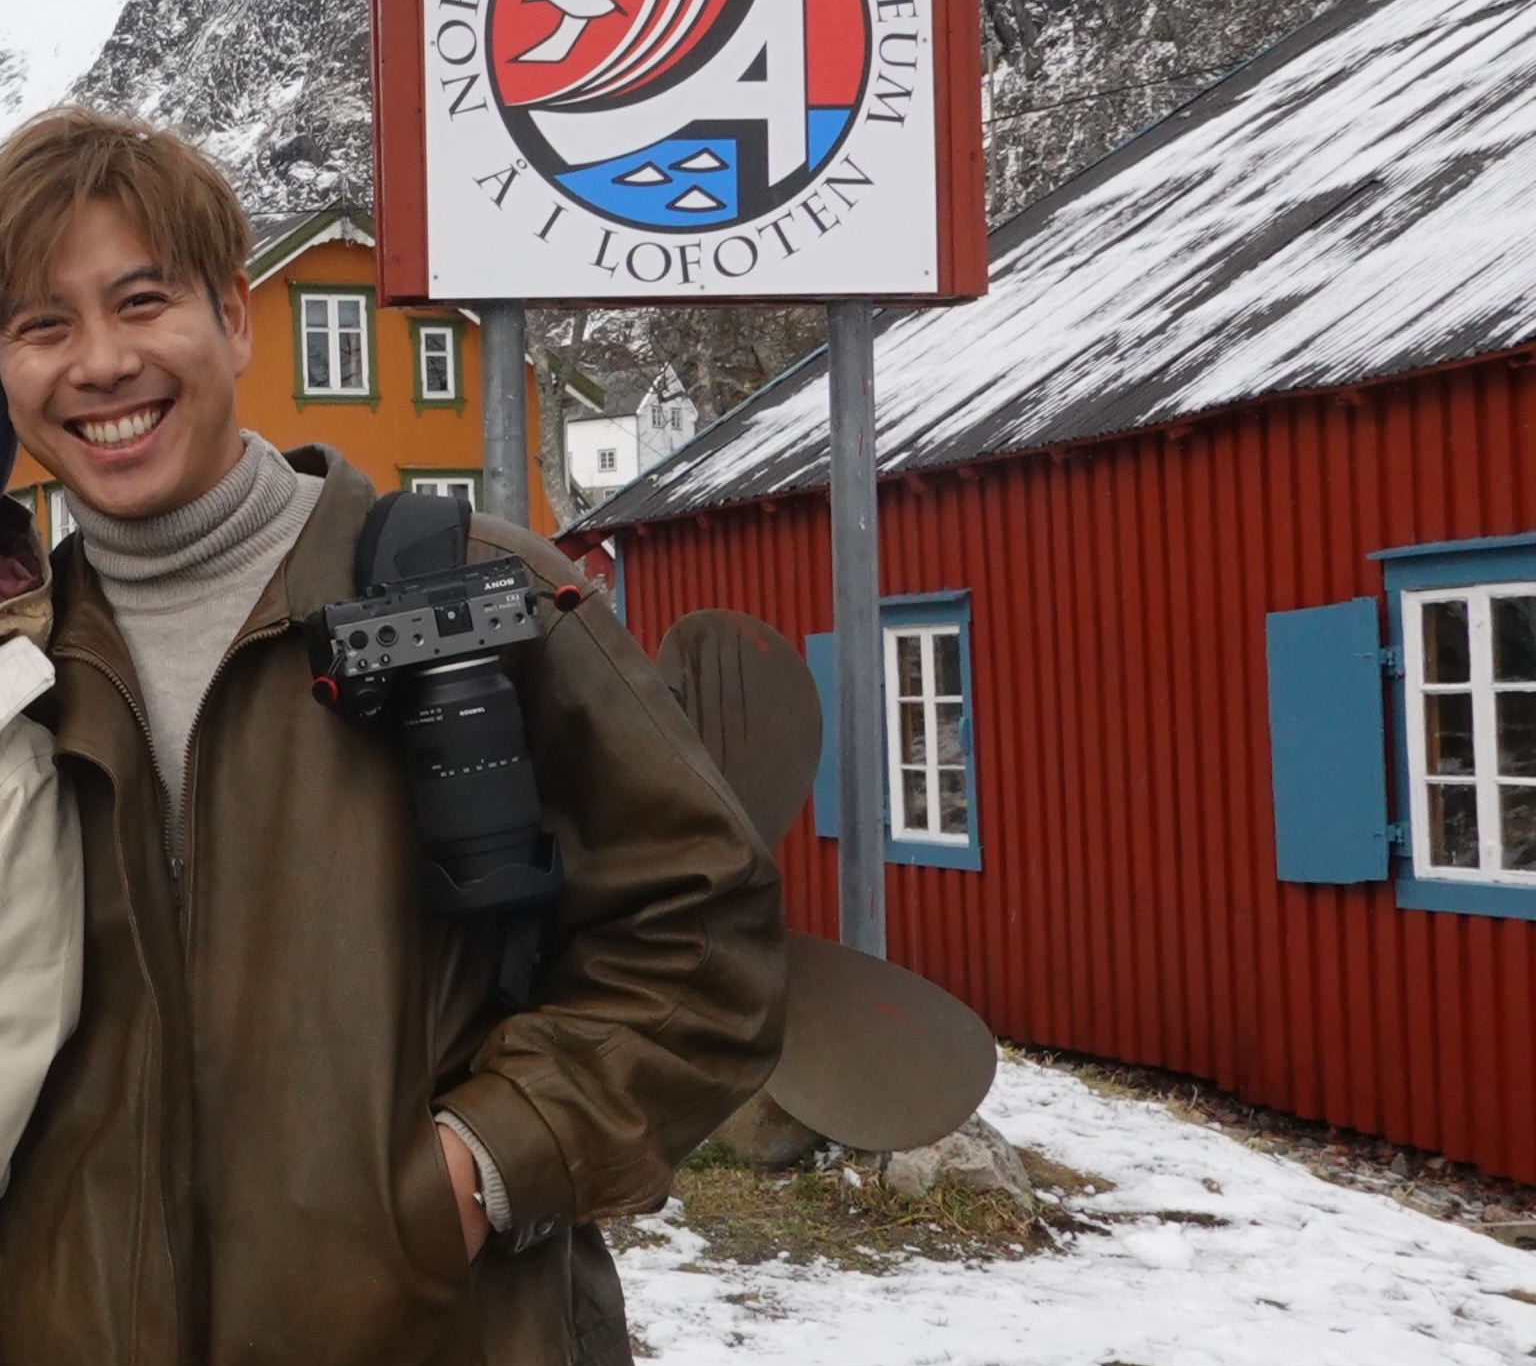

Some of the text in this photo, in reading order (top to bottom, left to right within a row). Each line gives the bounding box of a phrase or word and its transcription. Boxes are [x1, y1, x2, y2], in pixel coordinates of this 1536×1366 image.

[473, 153, 876, 286] Å I LOFOTEN
[484, 578, 515, 590] SONY
